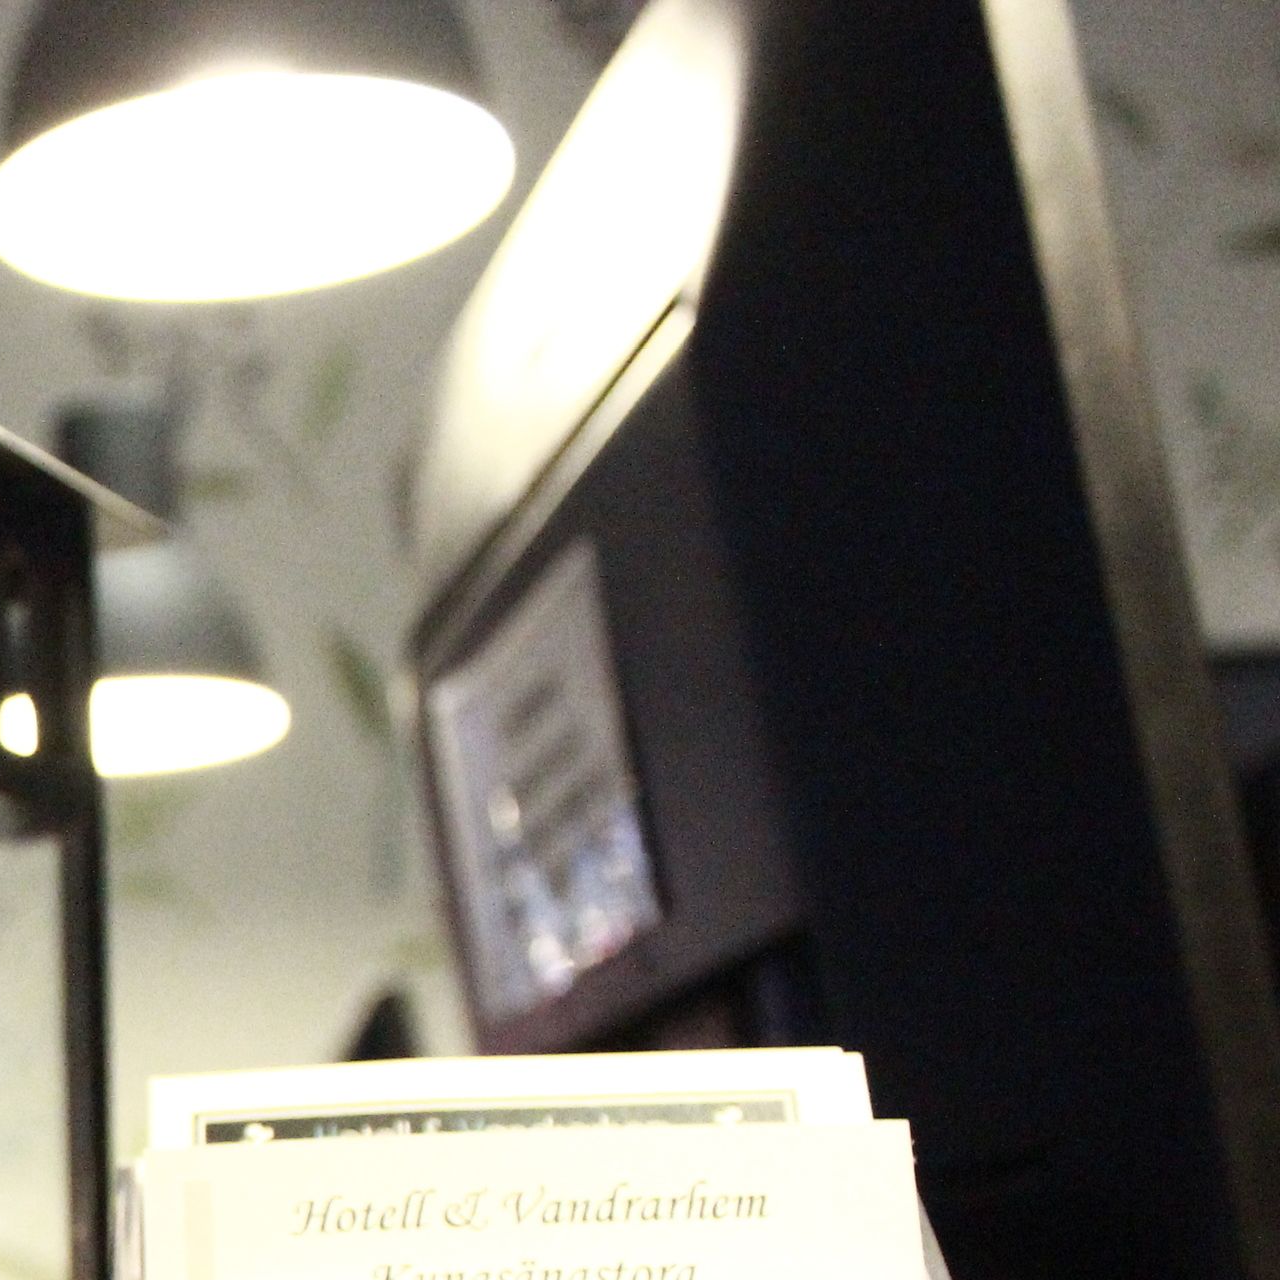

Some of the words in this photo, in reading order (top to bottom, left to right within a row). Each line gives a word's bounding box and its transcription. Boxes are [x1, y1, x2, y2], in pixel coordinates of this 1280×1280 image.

[291, 1188, 434, 1236] Hotell
[442, 1187, 490, 1231] &
[503, 1180, 768, 1227] Vandrarhem
